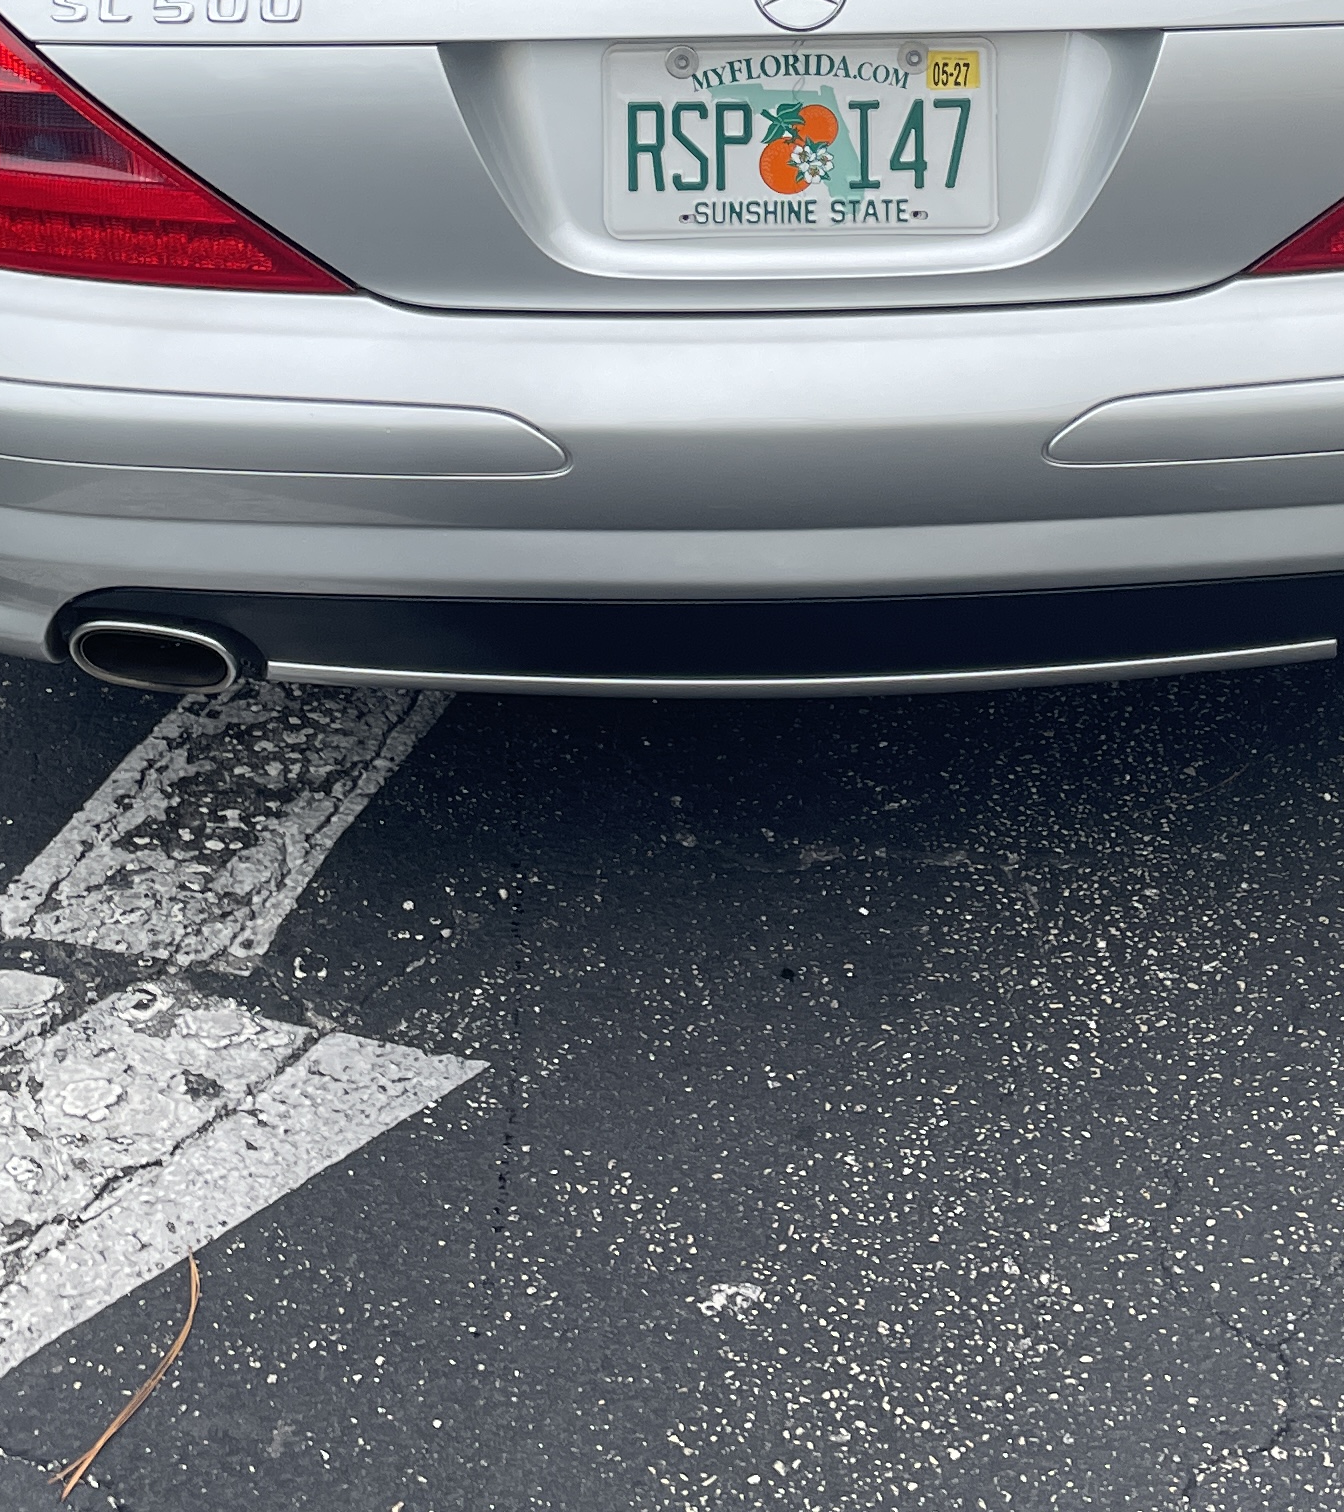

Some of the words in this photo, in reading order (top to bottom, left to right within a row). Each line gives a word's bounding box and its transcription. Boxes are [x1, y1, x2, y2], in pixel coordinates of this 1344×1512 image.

[691, 54, 910, 92] MYFLORIDA.COM
[932, 61, 971, 88] 05-27
[627, 100, 753, 192] RSP
[848, 98, 971, 190] I47
[694, 199, 817, 225] SUNSHINE
[829, 198, 910, 223] STATE
